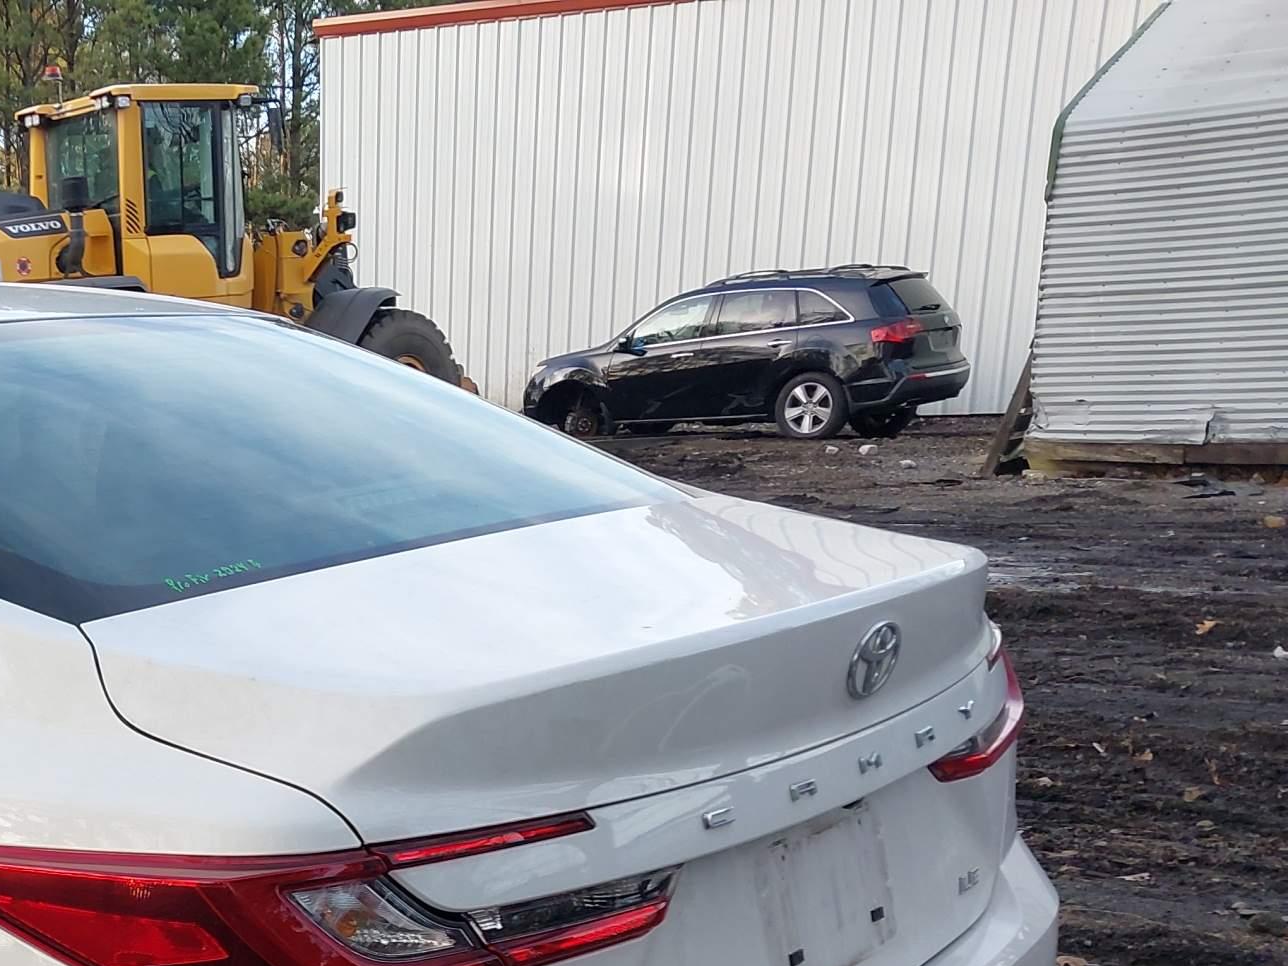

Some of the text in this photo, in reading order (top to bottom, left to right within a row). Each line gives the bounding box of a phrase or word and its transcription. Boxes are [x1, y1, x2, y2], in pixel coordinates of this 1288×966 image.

[5, 220, 62, 234] VOLVO
[702, 700, 975, 830] CAMRY
[958, 867, 980, 896] LE
